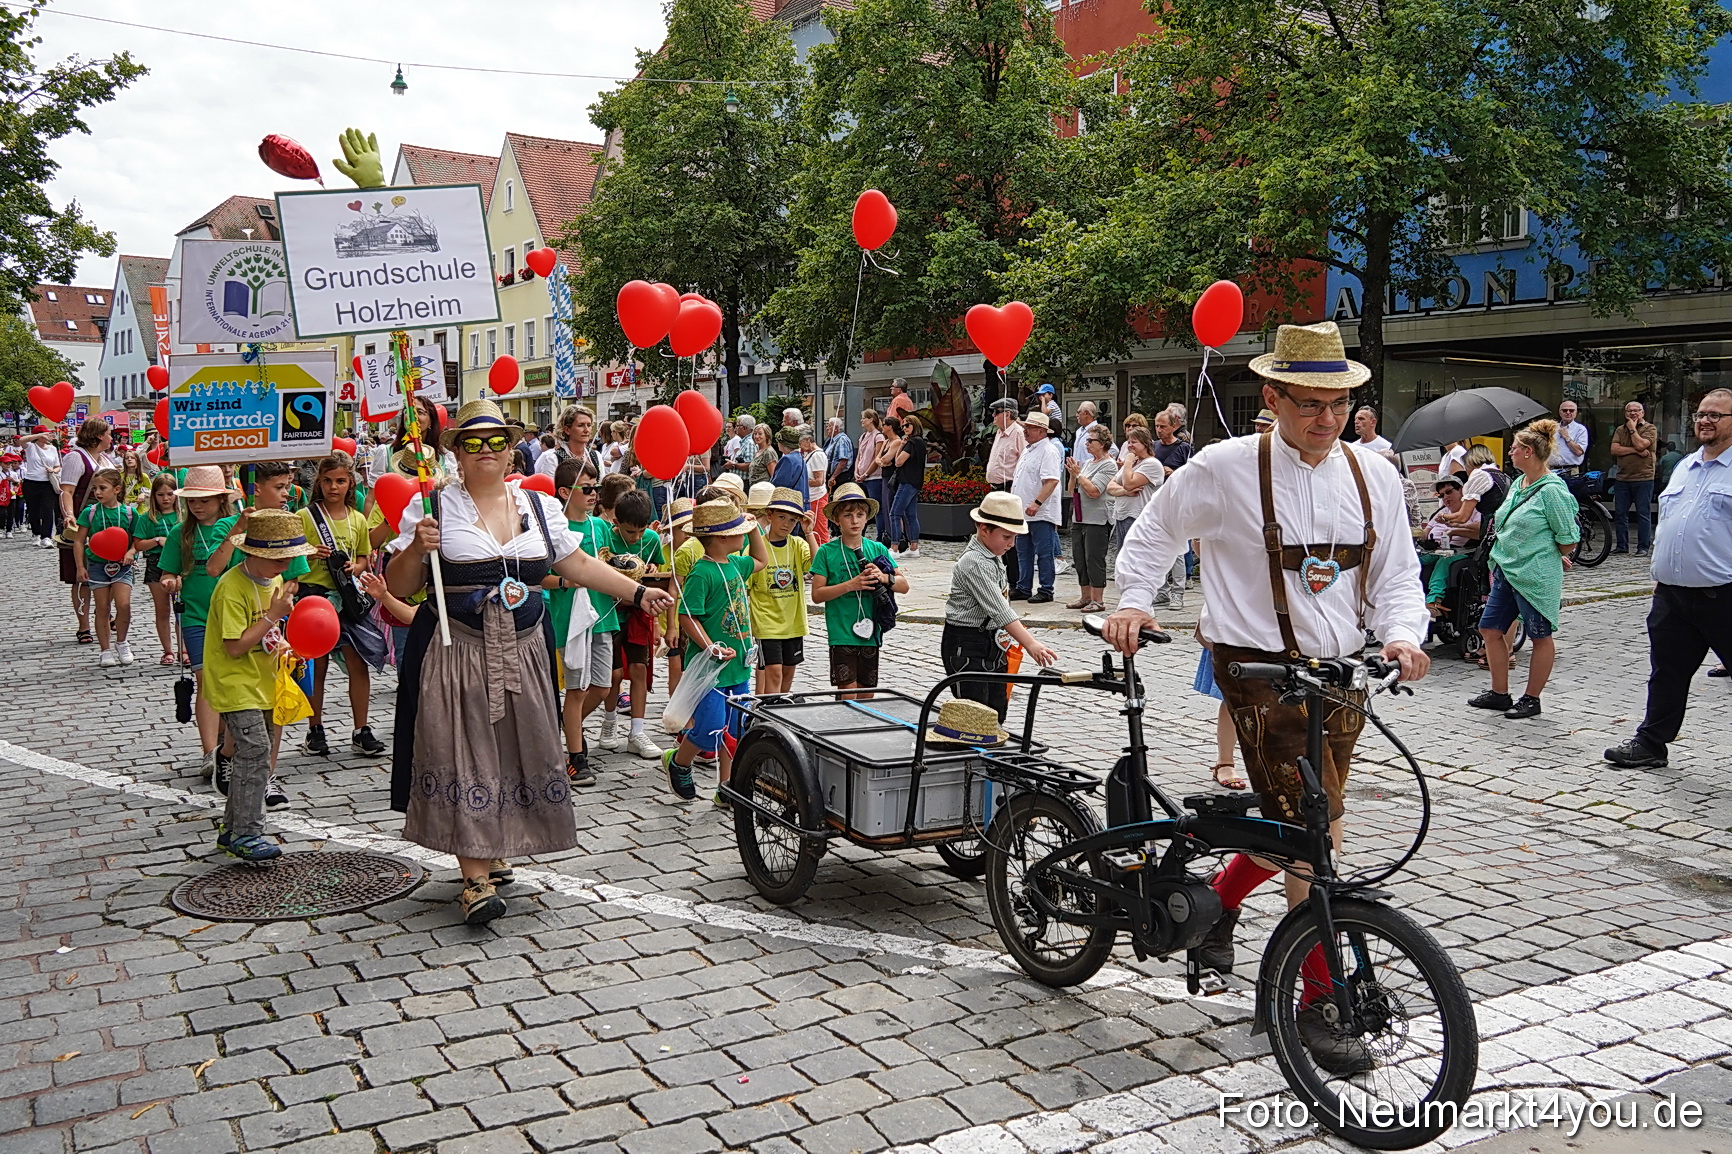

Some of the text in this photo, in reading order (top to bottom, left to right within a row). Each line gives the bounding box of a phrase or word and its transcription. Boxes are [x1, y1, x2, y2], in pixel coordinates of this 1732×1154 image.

[207, 245, 282, 286] UMWELTSCHULE IN
[304, 258, 476, 291] Grundschule
[205, 289, 247, 338] INTERNATIONALE
[248, 324, 282, 339] AGENDA
[335, 295, 462, 325] Holzheim
[367, 358, 380, 390] SINUS
[174, 398, 242, 412] Wir sind
[172, 411, 275, 431] Fairtrade
[283, 431, 323, 439] FAIRTRADE
[199, 432, 265, 449] School
